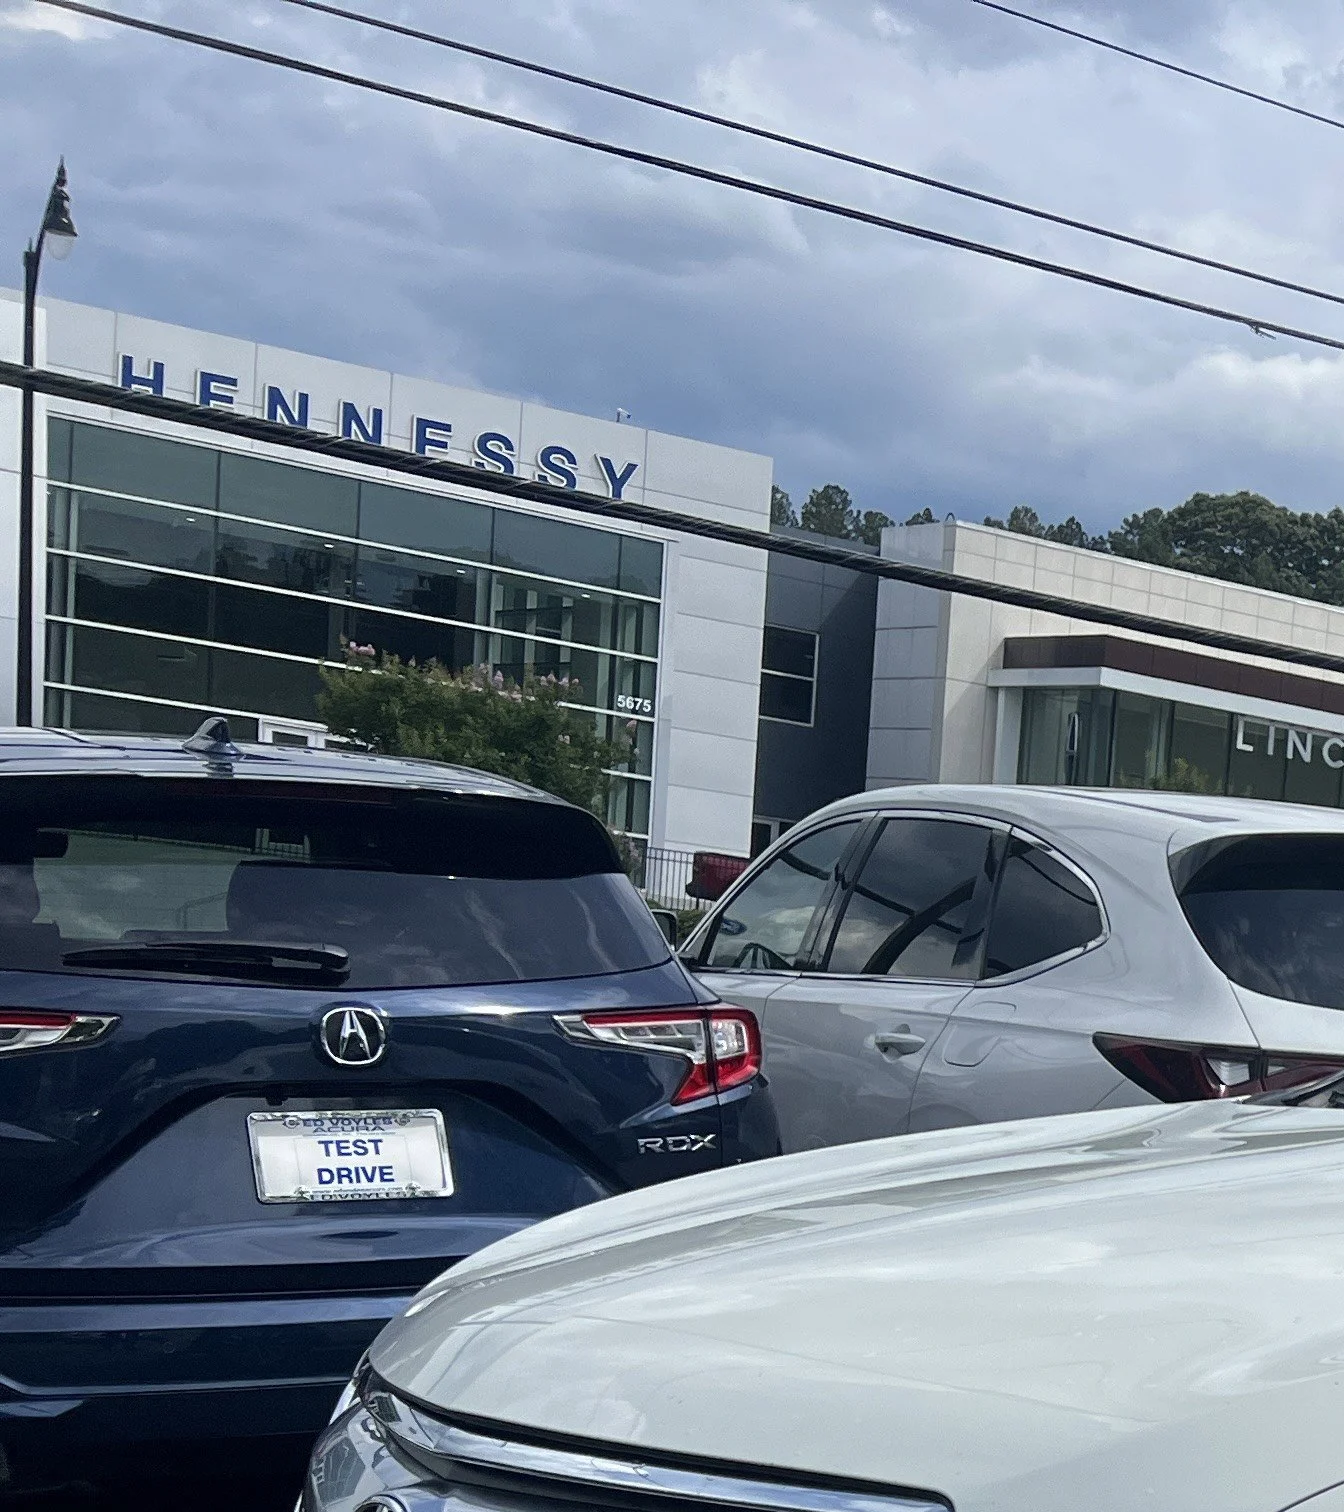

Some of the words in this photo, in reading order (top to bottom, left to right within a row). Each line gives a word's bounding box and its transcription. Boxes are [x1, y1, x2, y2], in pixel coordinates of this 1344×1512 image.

[117, 353, 638, 498] HENNESSY
[617, 694, 652, 713] 5675
[312, 1125, 386, 1134] ACURA
[317, 1138, 384, 1158] TEST
[637, 1133, 717, 1154] RDX
[316, 1164, 396, 1186] DRIVE
